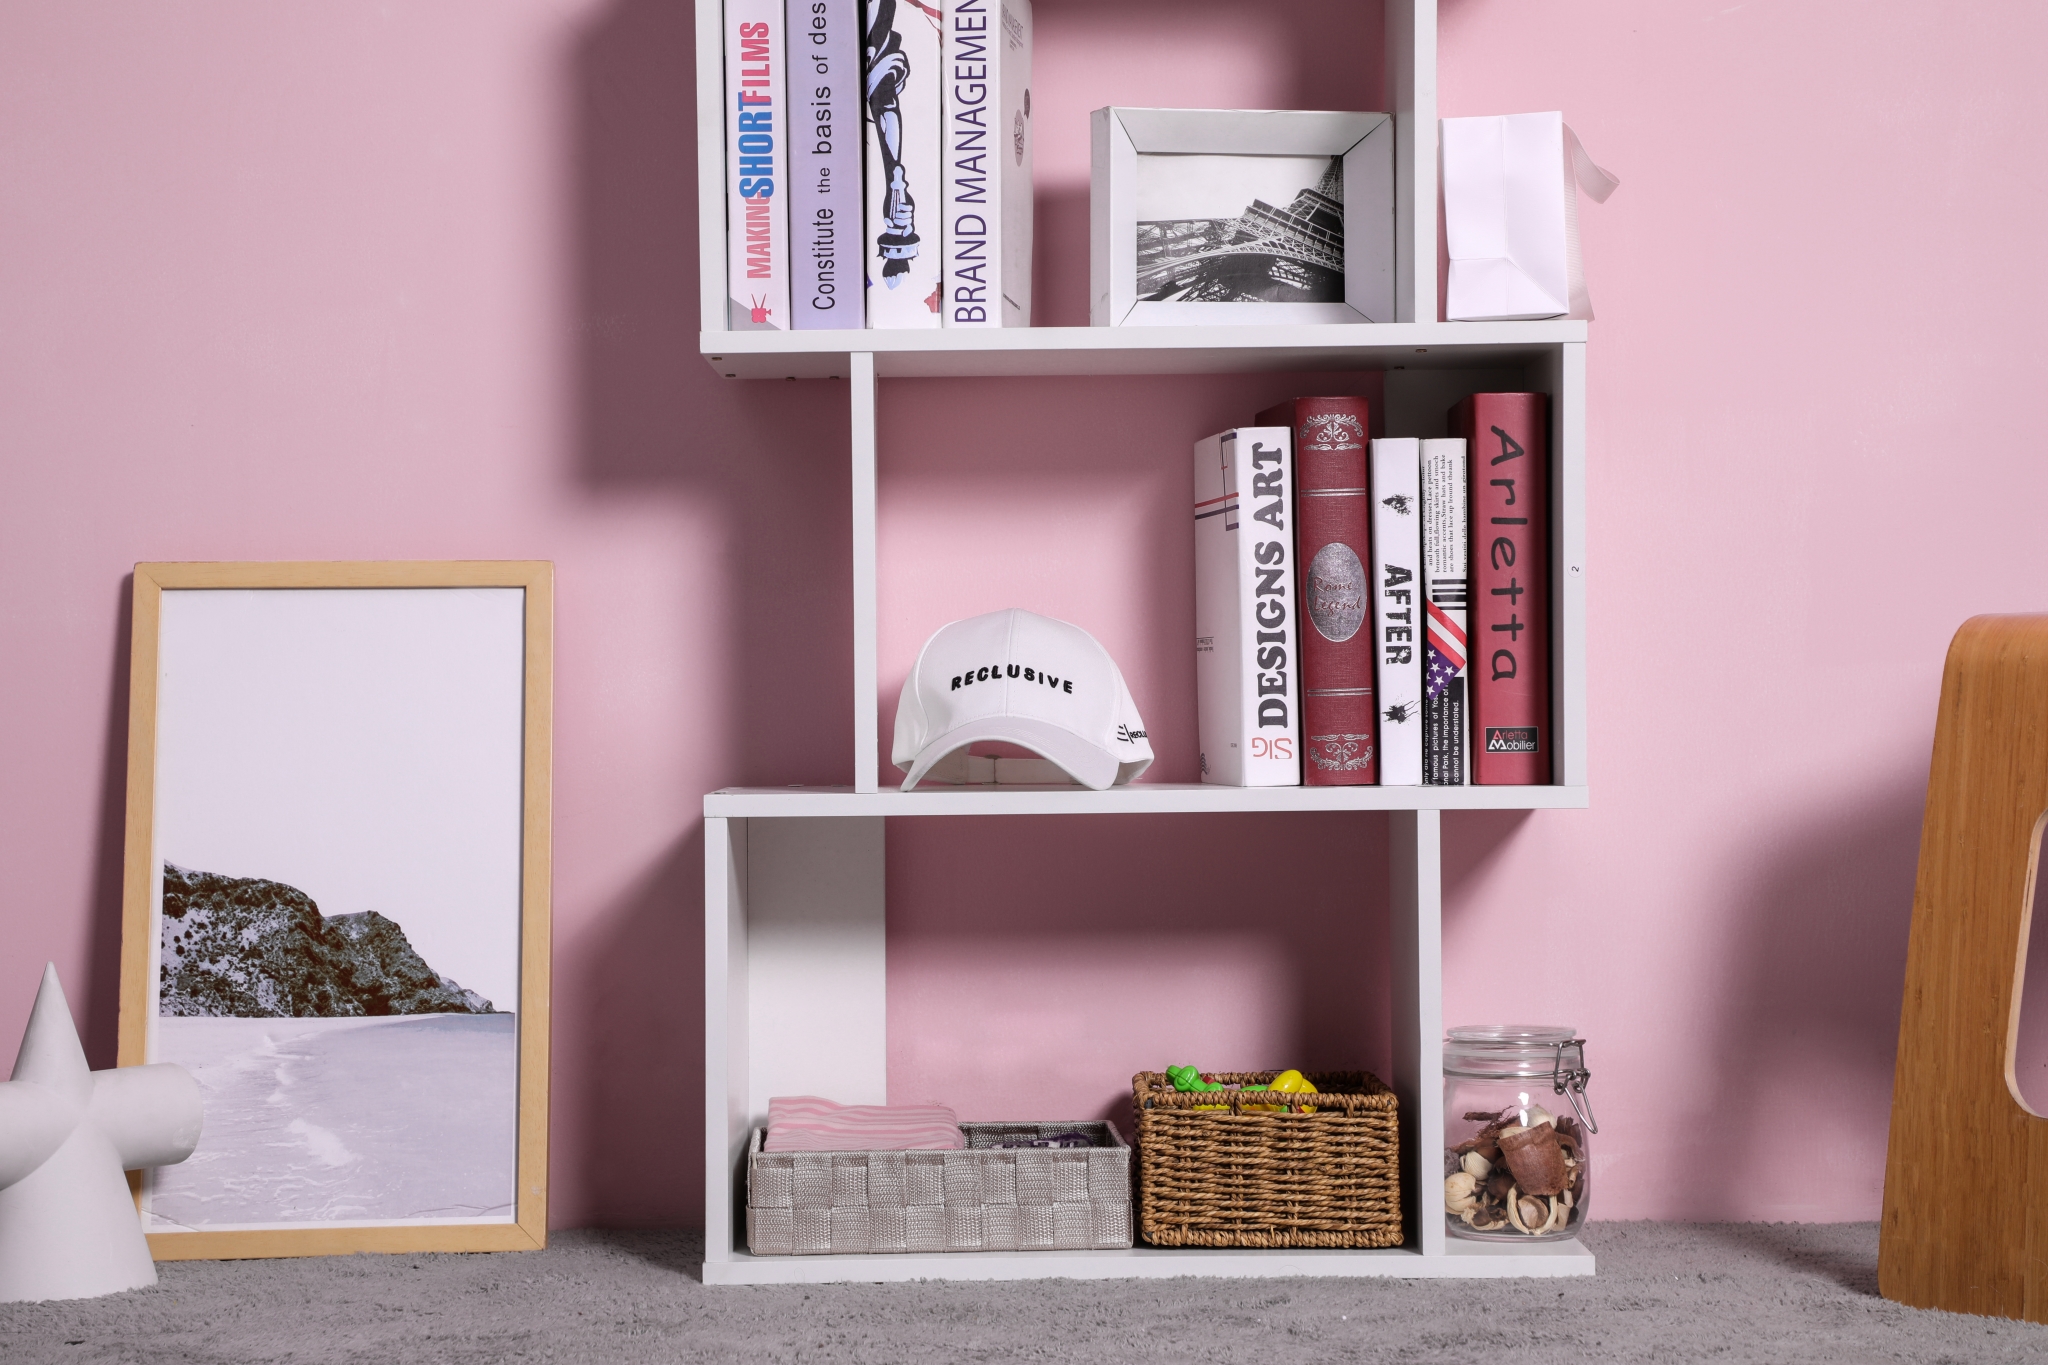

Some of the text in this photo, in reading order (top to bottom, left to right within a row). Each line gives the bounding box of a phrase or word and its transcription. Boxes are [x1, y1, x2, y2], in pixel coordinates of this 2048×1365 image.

[740, 22, 771, 103] FILMS
[738, 91, 774, 198] SHORT
[808, 2, 835, 310] Constitute the basis of des
[955, 0, 986, 322] BRAND MANAGEMEN
[1448, 505, 1454, 514] up
[1428, 526, 1433, 535] on
[1490, 425, 1528, 681] Arletta
[1571, 565, 1580, 573] 2
[1252, 442, 1289, 729] DESIGNS ART
[1313, 576, 1353, 592] Rome
[1314, 595, 1361, 617] Legend
[1384, 563, 1413, 665] AFTER
[951, 664, 1073, 694] RECLUSIVE
[1442, 687, 1449, 696] of
[1432, 711, 1438, 720] of
[1488, 739, 1535, 750] Mobilier
[1493, 730, 1528, 740] Arletta
[1453, 746, 1459, 756] be
